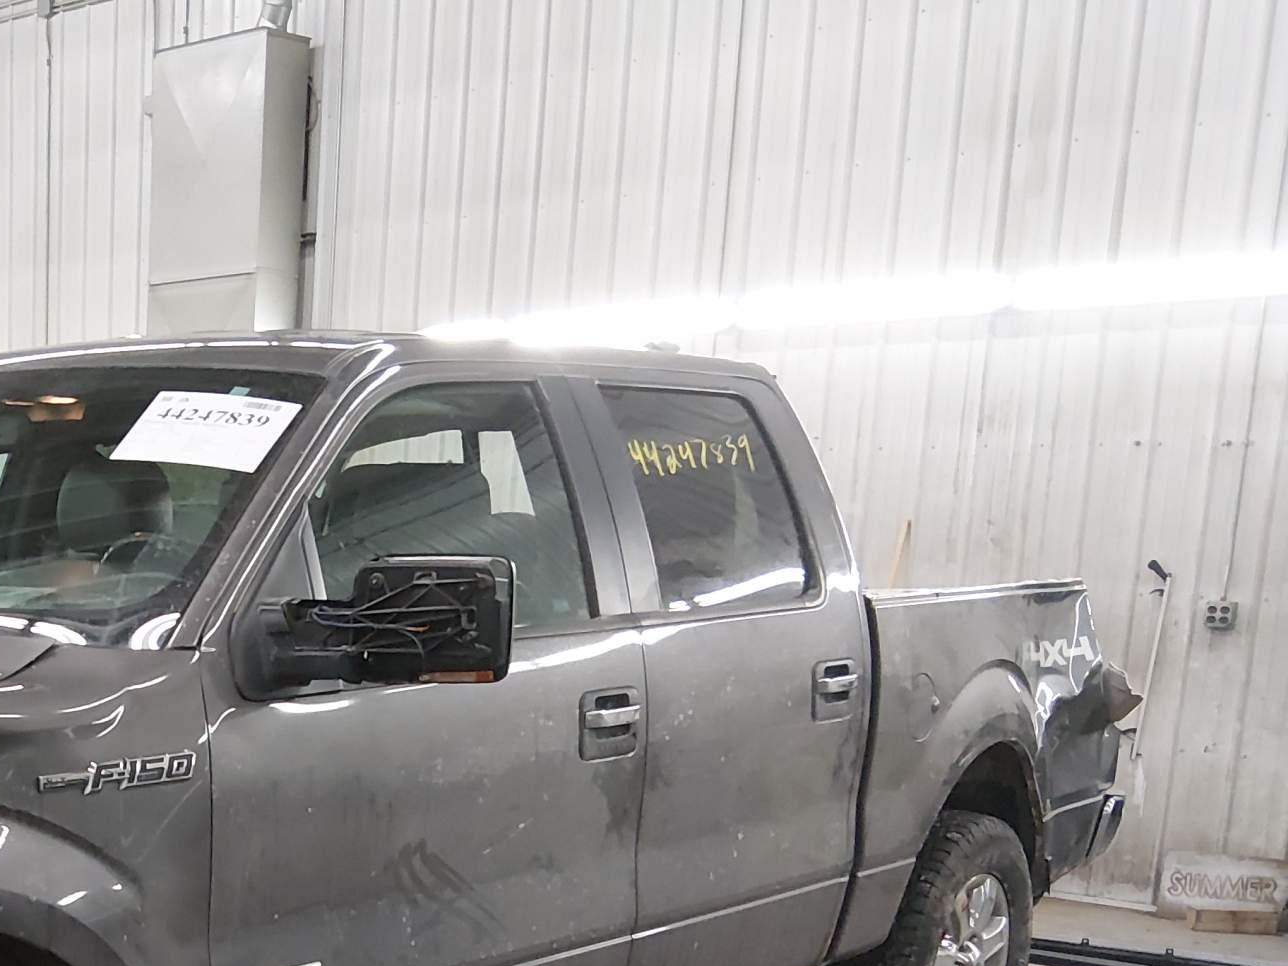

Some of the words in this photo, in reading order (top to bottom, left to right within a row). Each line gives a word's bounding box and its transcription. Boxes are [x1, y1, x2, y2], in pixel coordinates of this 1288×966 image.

[158, 407, 270, 427] 44247839
[627, 433, 755, 476] 44247839
[1168, 870, 1278, 904] SUMMER
